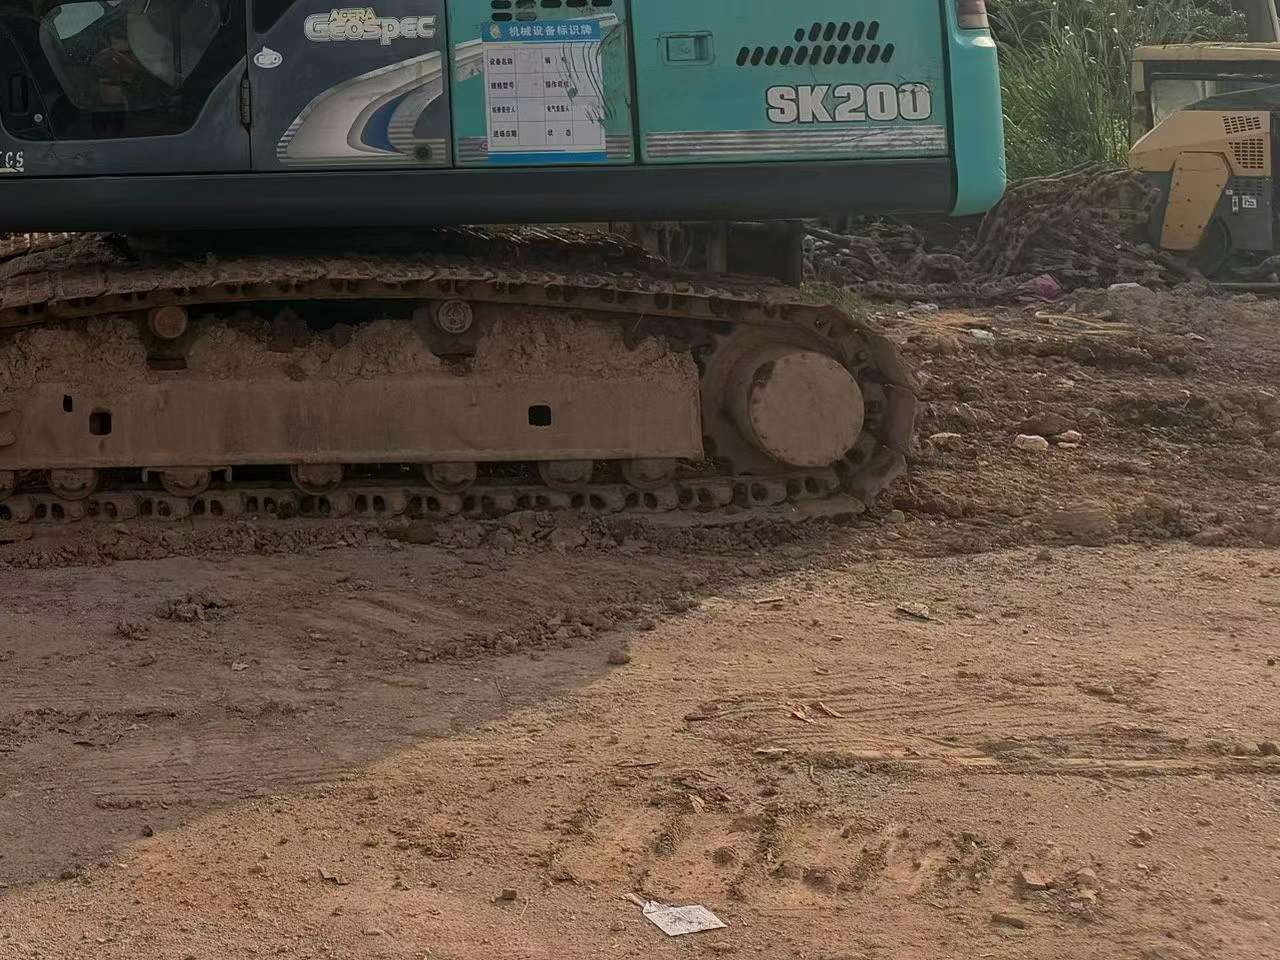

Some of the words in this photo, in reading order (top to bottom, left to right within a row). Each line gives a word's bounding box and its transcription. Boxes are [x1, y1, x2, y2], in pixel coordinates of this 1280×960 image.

[509, 24, 593, 38] 机械设备标识牌
[766, 82, 932, 123] SK200
